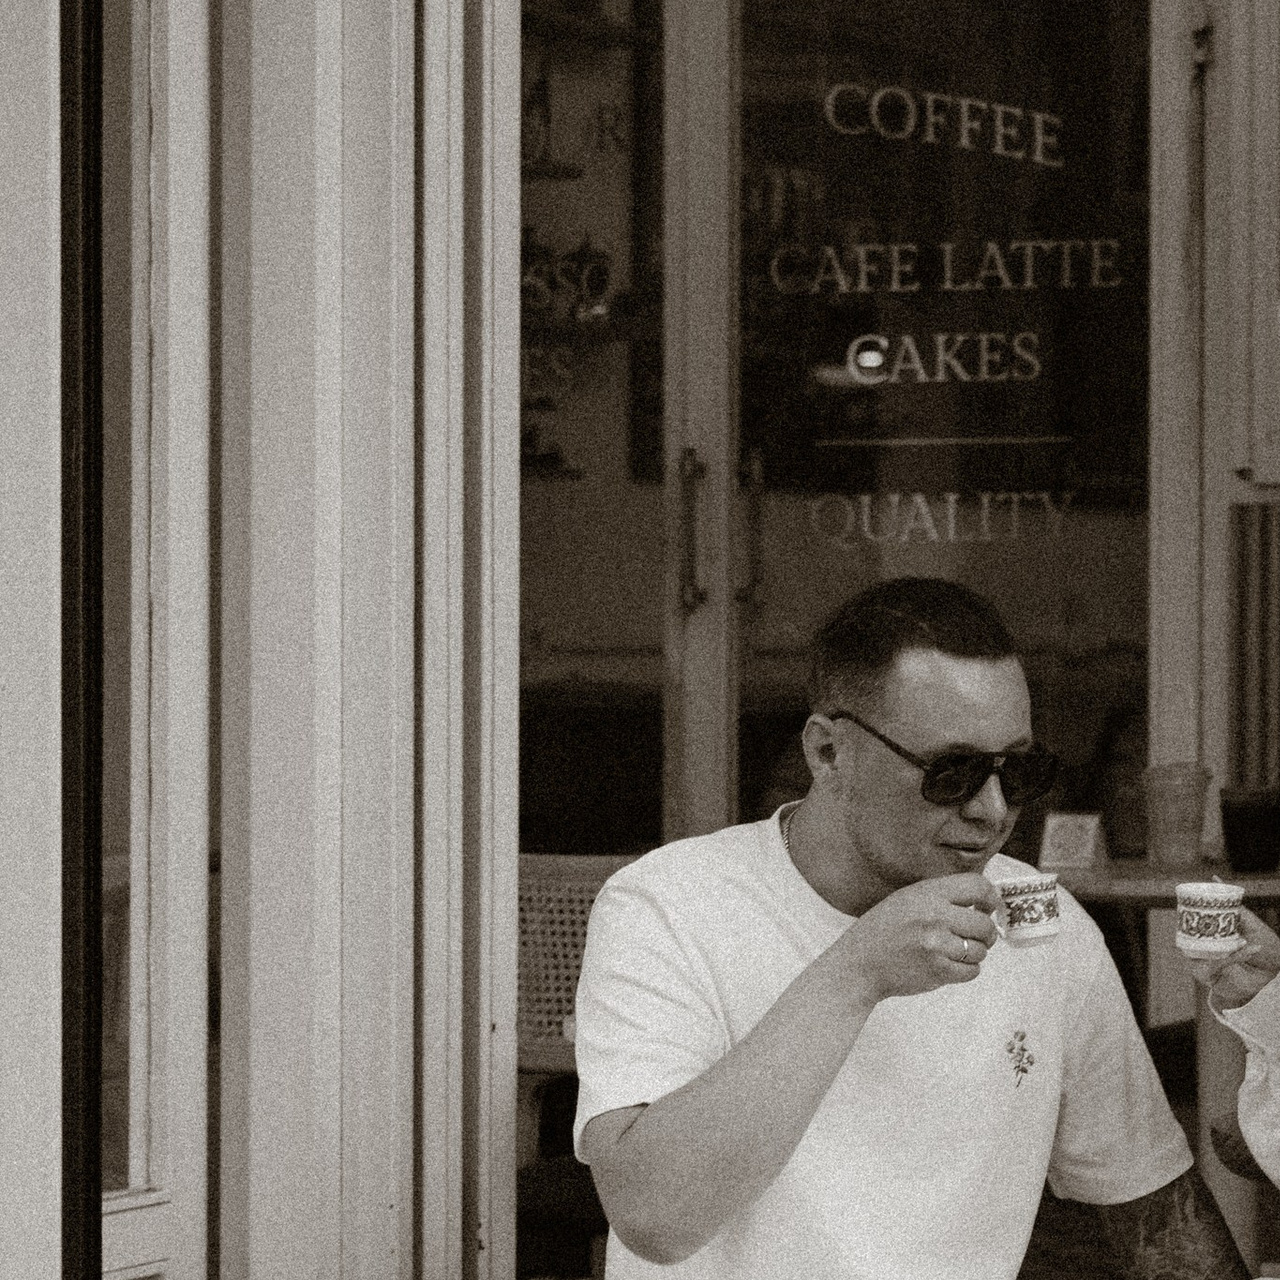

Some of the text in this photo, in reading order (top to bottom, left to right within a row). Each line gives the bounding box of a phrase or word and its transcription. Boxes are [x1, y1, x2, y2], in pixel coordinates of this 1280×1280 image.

[824, 83, 1066, 168] COFFEE
[769, 239, 1124, 294] CAFE LATTE
[846, 333, 1042, 385] CAKES
[810, 491, 1077, 550] QUALITY
